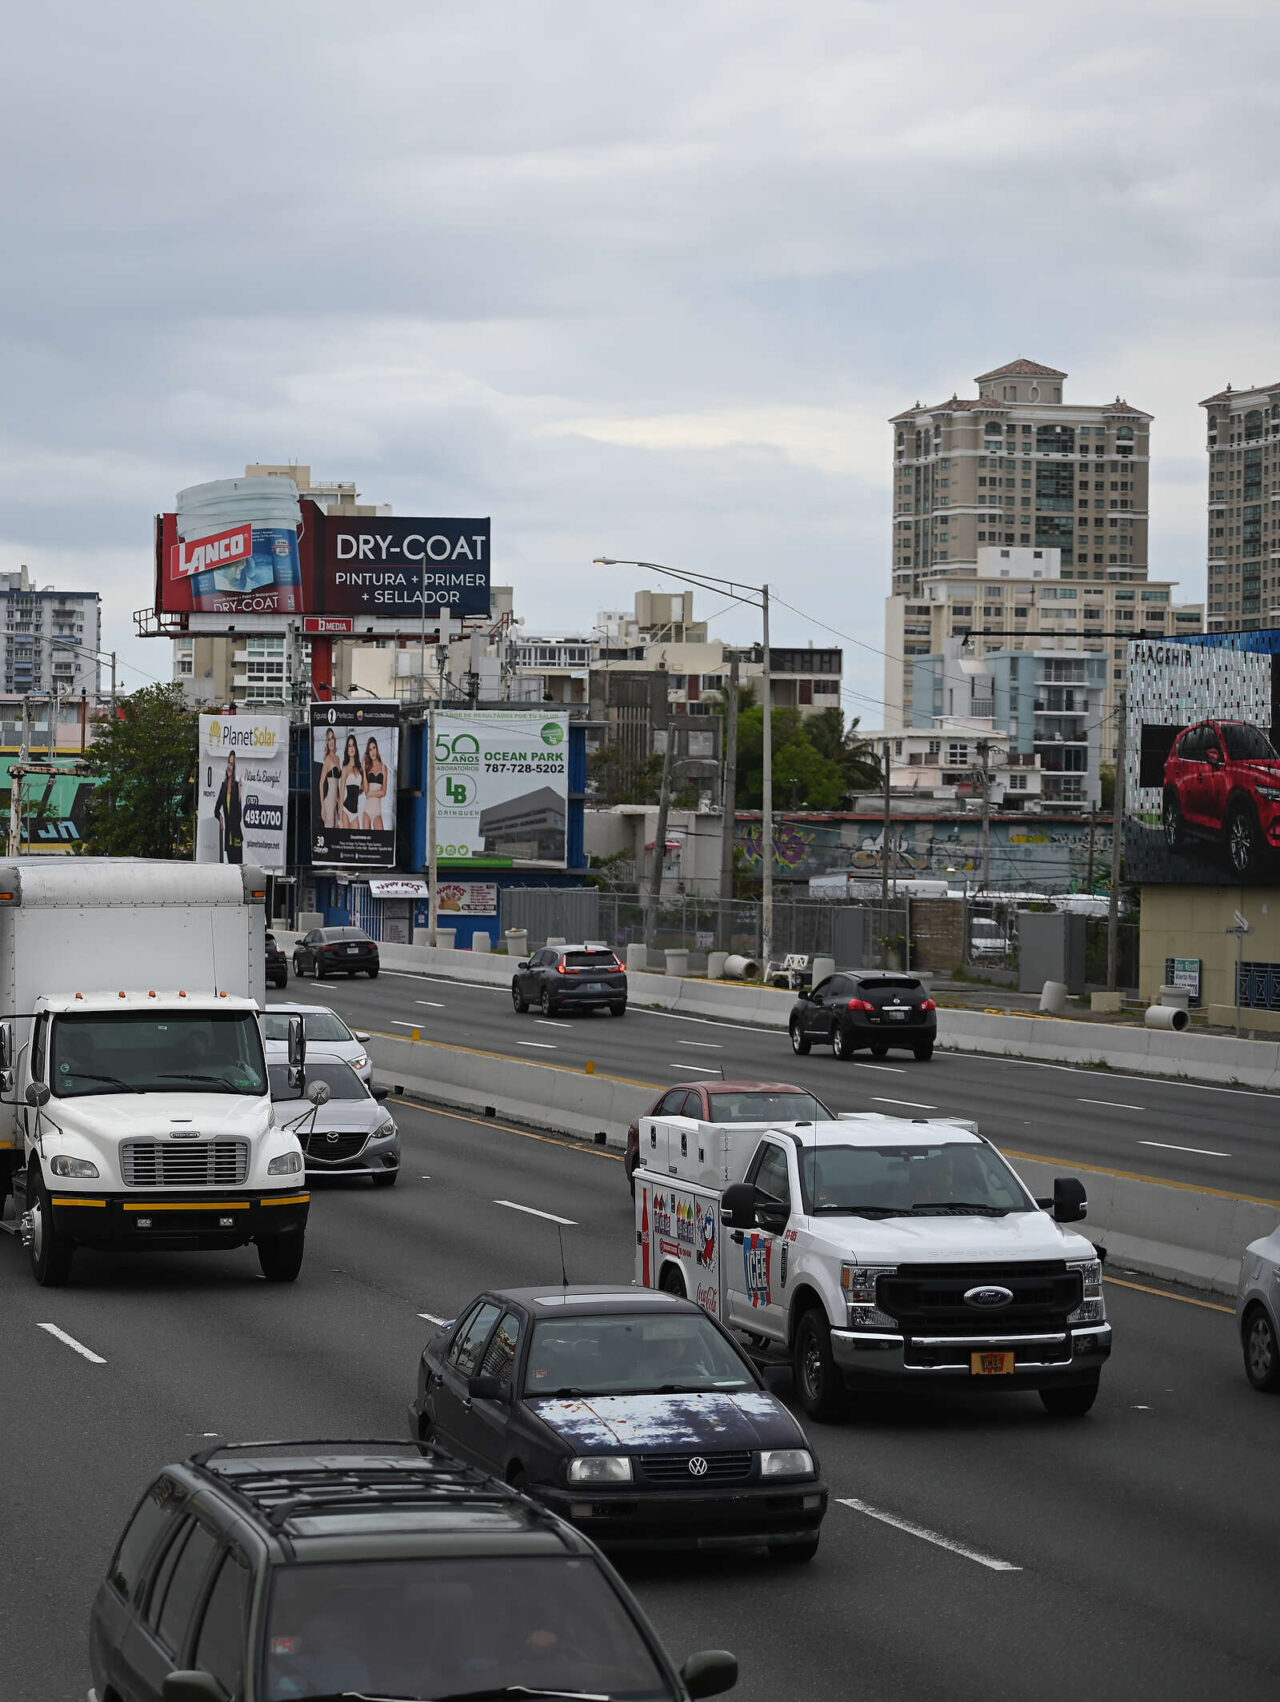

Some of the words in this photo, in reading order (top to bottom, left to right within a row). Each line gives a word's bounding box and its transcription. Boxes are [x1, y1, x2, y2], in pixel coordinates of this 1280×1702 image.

[178, 533, 245, 576] LANCO
[336, 534, 487, 561] DRY-COAT
[335, 572, 407, 586] PINTURA
[424, 573, 486, 587] PRIMER
[213, 596, 279, 613] DRY-COAT
[374, 590, 460, 604] SELLADOR
[223, 725, 277, 747] PlanetSolar
[451, 753, 480, 763] AÑOS
[484, 752, 528, 762] OCEAN
[531, 752, 564, 762] PARK
[484, 763, 566, 774] 787-728-5202
[446, 776, 467, 804] LB
[978, 1291, 1001, 1303] Ford
